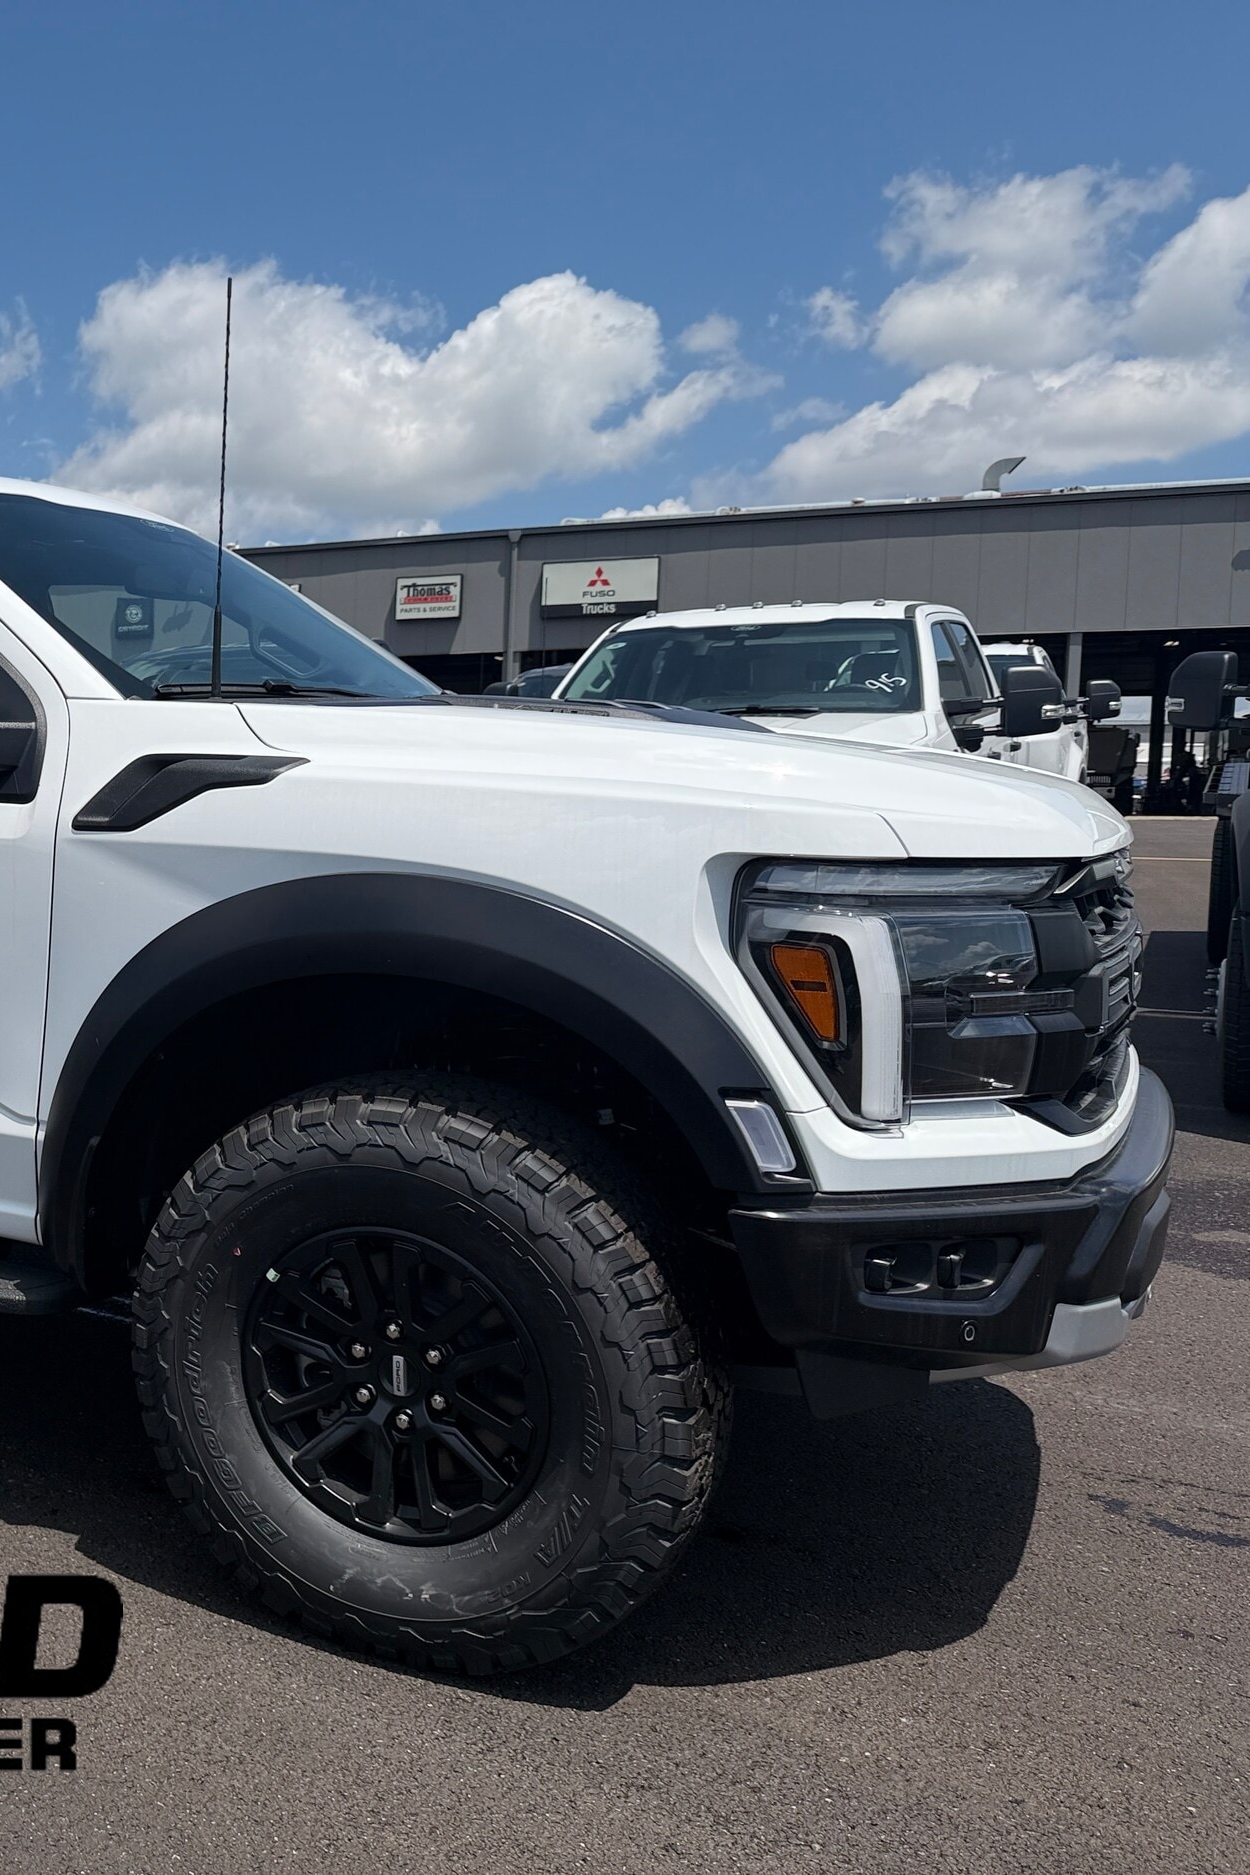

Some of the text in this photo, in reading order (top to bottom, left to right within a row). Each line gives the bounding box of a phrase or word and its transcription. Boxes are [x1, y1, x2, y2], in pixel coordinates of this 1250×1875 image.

[400, 582, 457, 598] Thomas
[582, 589, 617, 598] FUSO
[429, 605, 457, 613] SERVICE
[581, 602, 617, 615] Trucks
[181, 1262, 288, 1536] BFGoodrich
